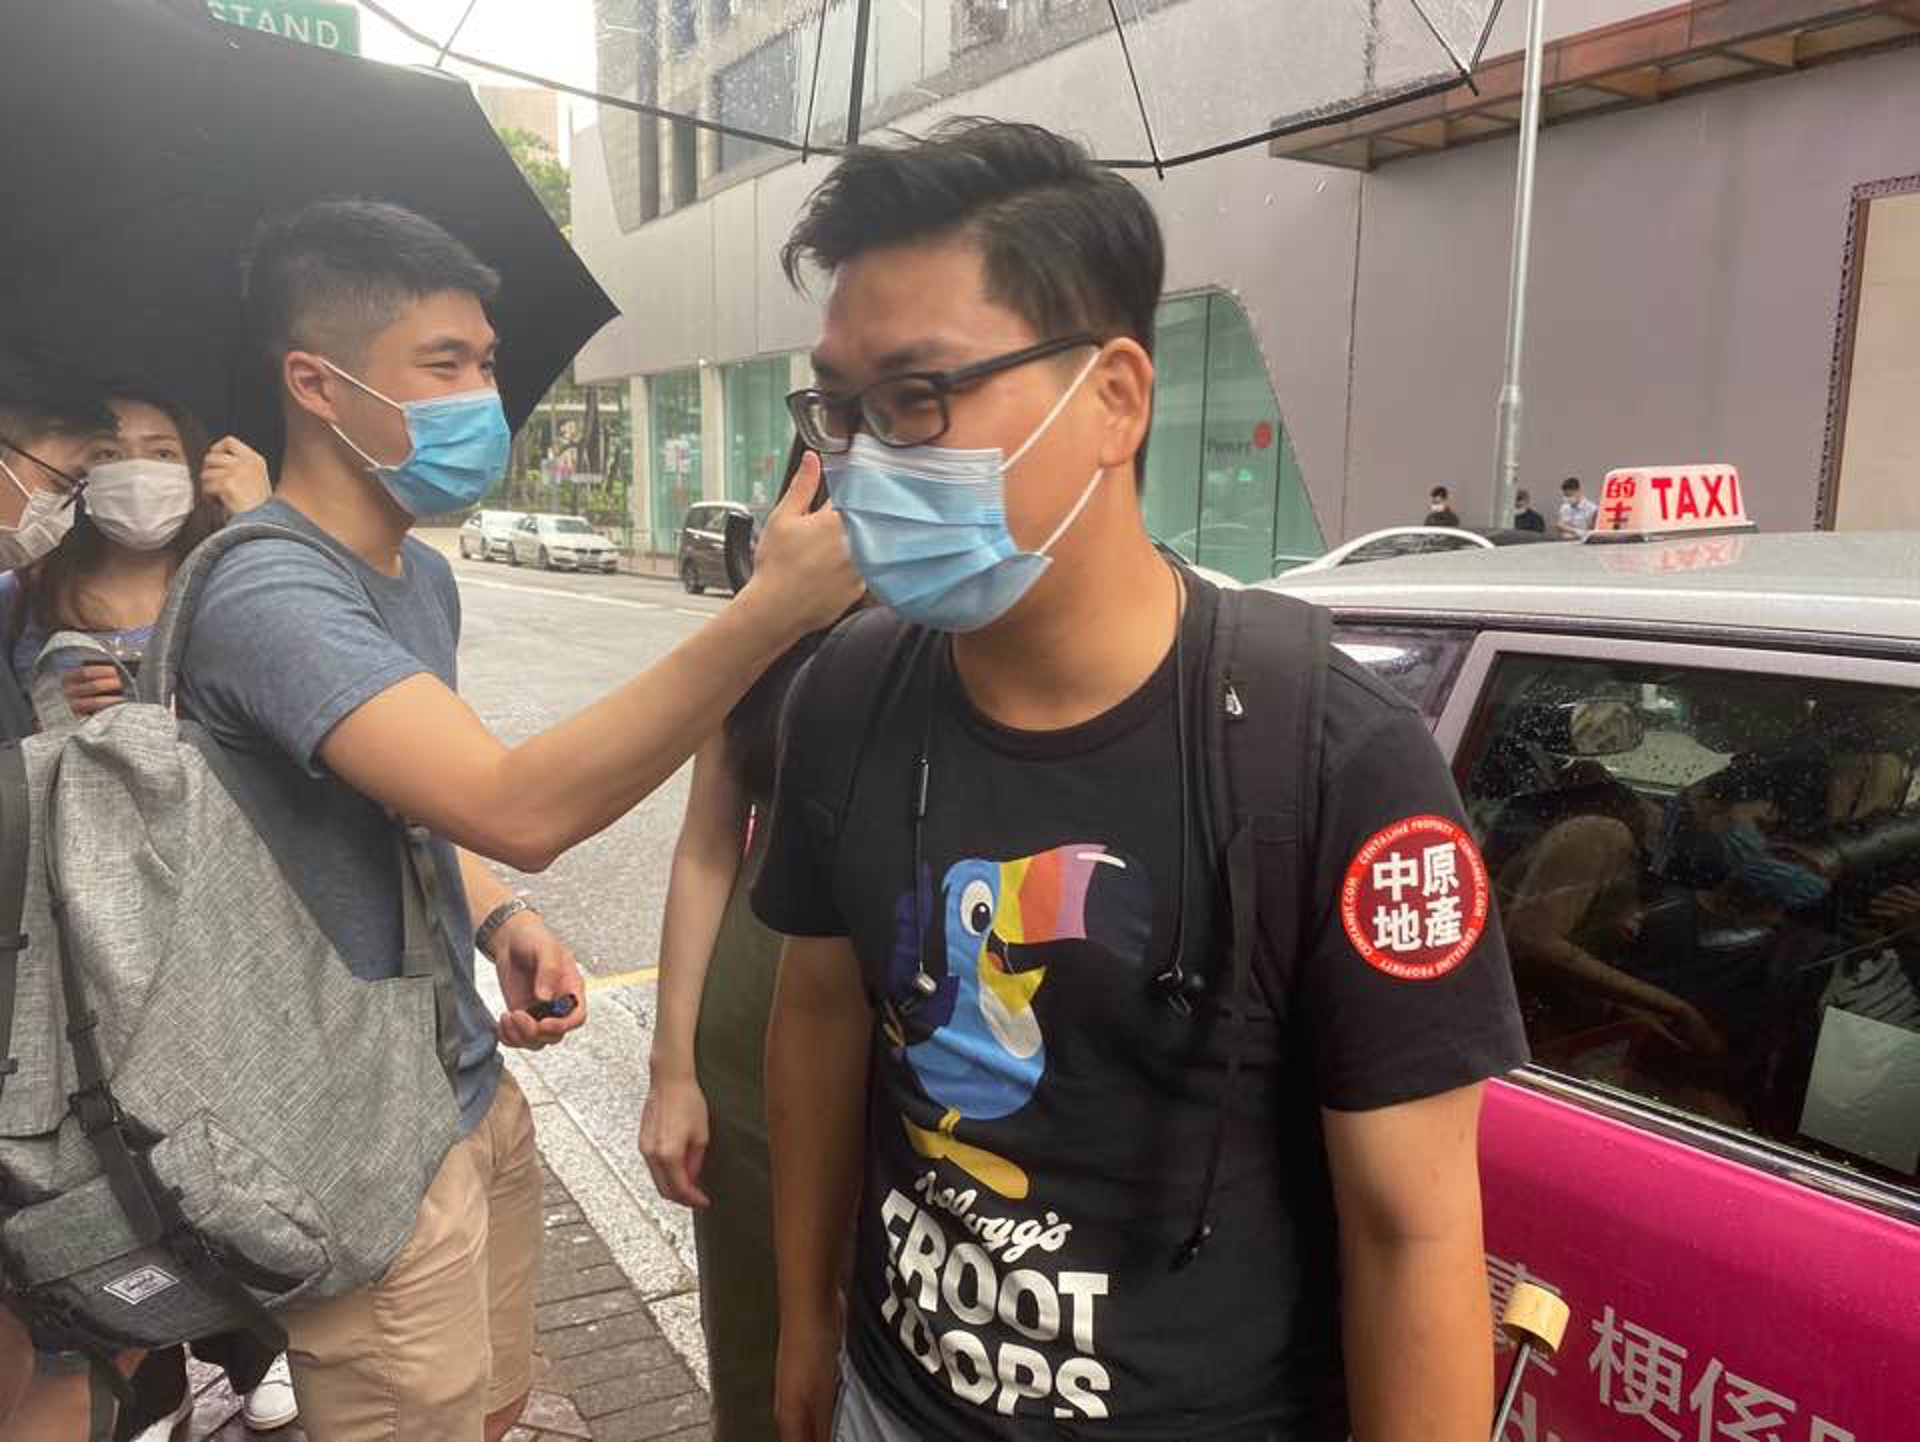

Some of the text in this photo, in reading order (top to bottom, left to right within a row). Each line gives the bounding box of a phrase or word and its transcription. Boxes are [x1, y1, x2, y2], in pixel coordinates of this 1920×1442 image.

[207, 0, 340, 49] STAND
[1604, 476, 1637, 530] 的士
[1651, 475, 1738, 520] TAXI
[1373, 842, 1460, 901] 中原
[1372, 896, 1463, 952] 地產
[881, 1188, 1109, 1356] FROOT
